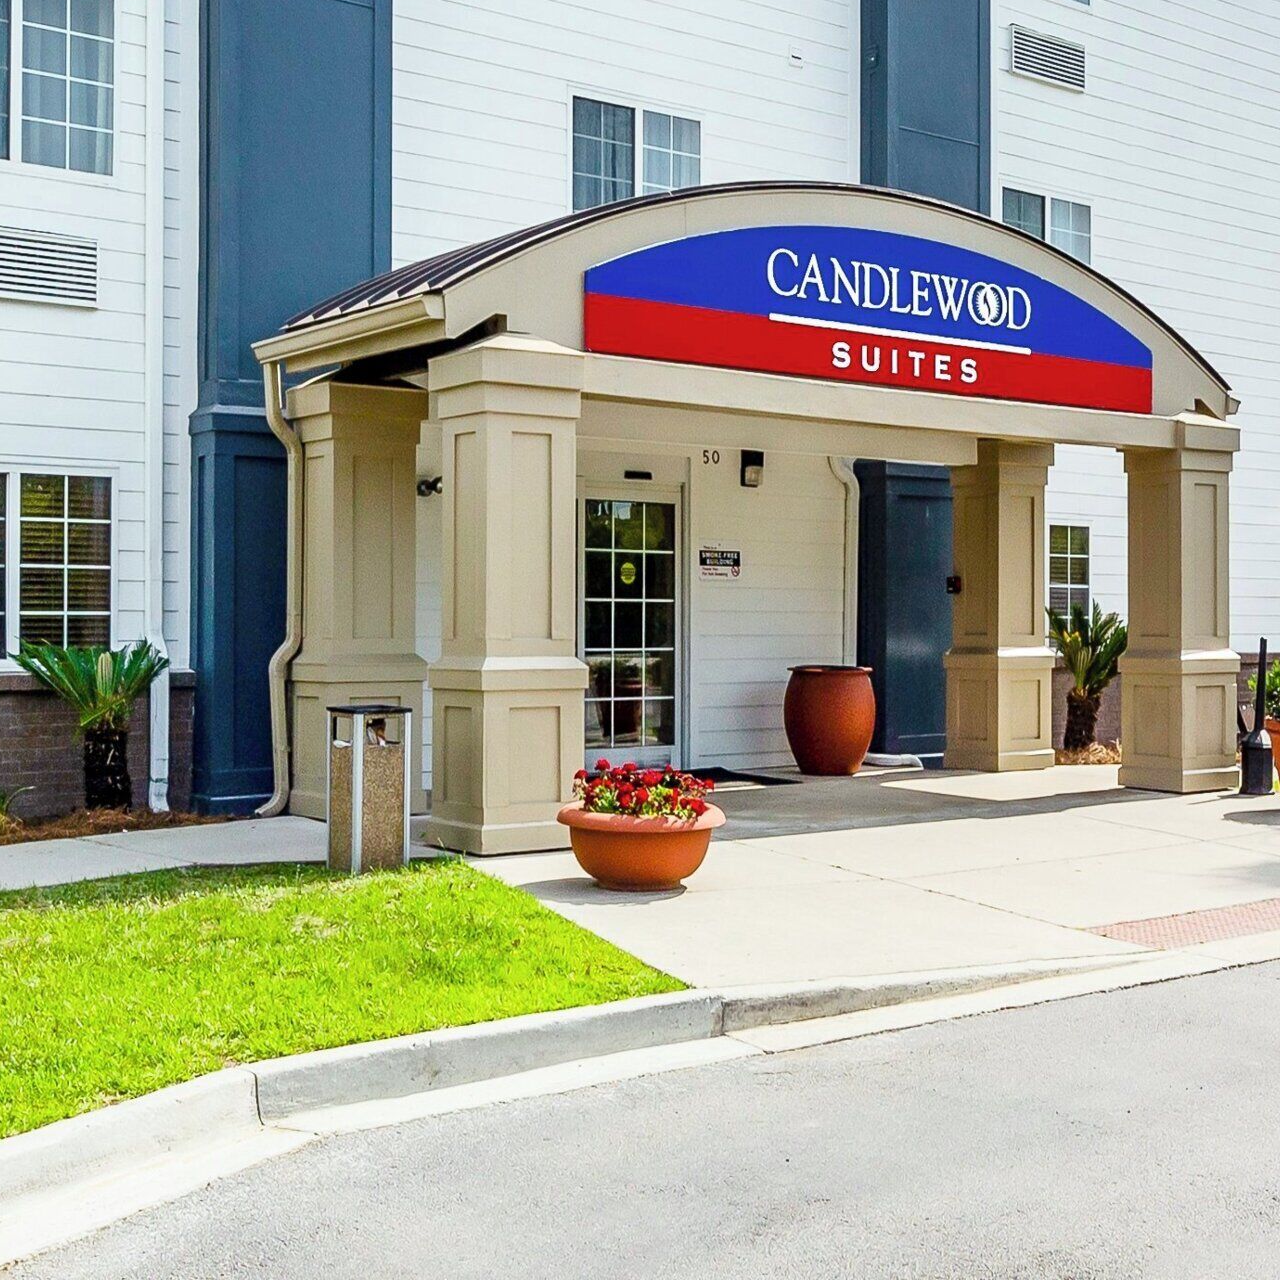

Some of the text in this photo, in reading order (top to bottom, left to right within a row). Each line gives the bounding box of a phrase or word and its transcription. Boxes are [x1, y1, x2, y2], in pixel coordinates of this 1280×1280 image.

[766, 247, 1032, 330] CANDLEWOOD
[831, 341, 978, 384] SUITES
[703, 449, 720, 464] 50
